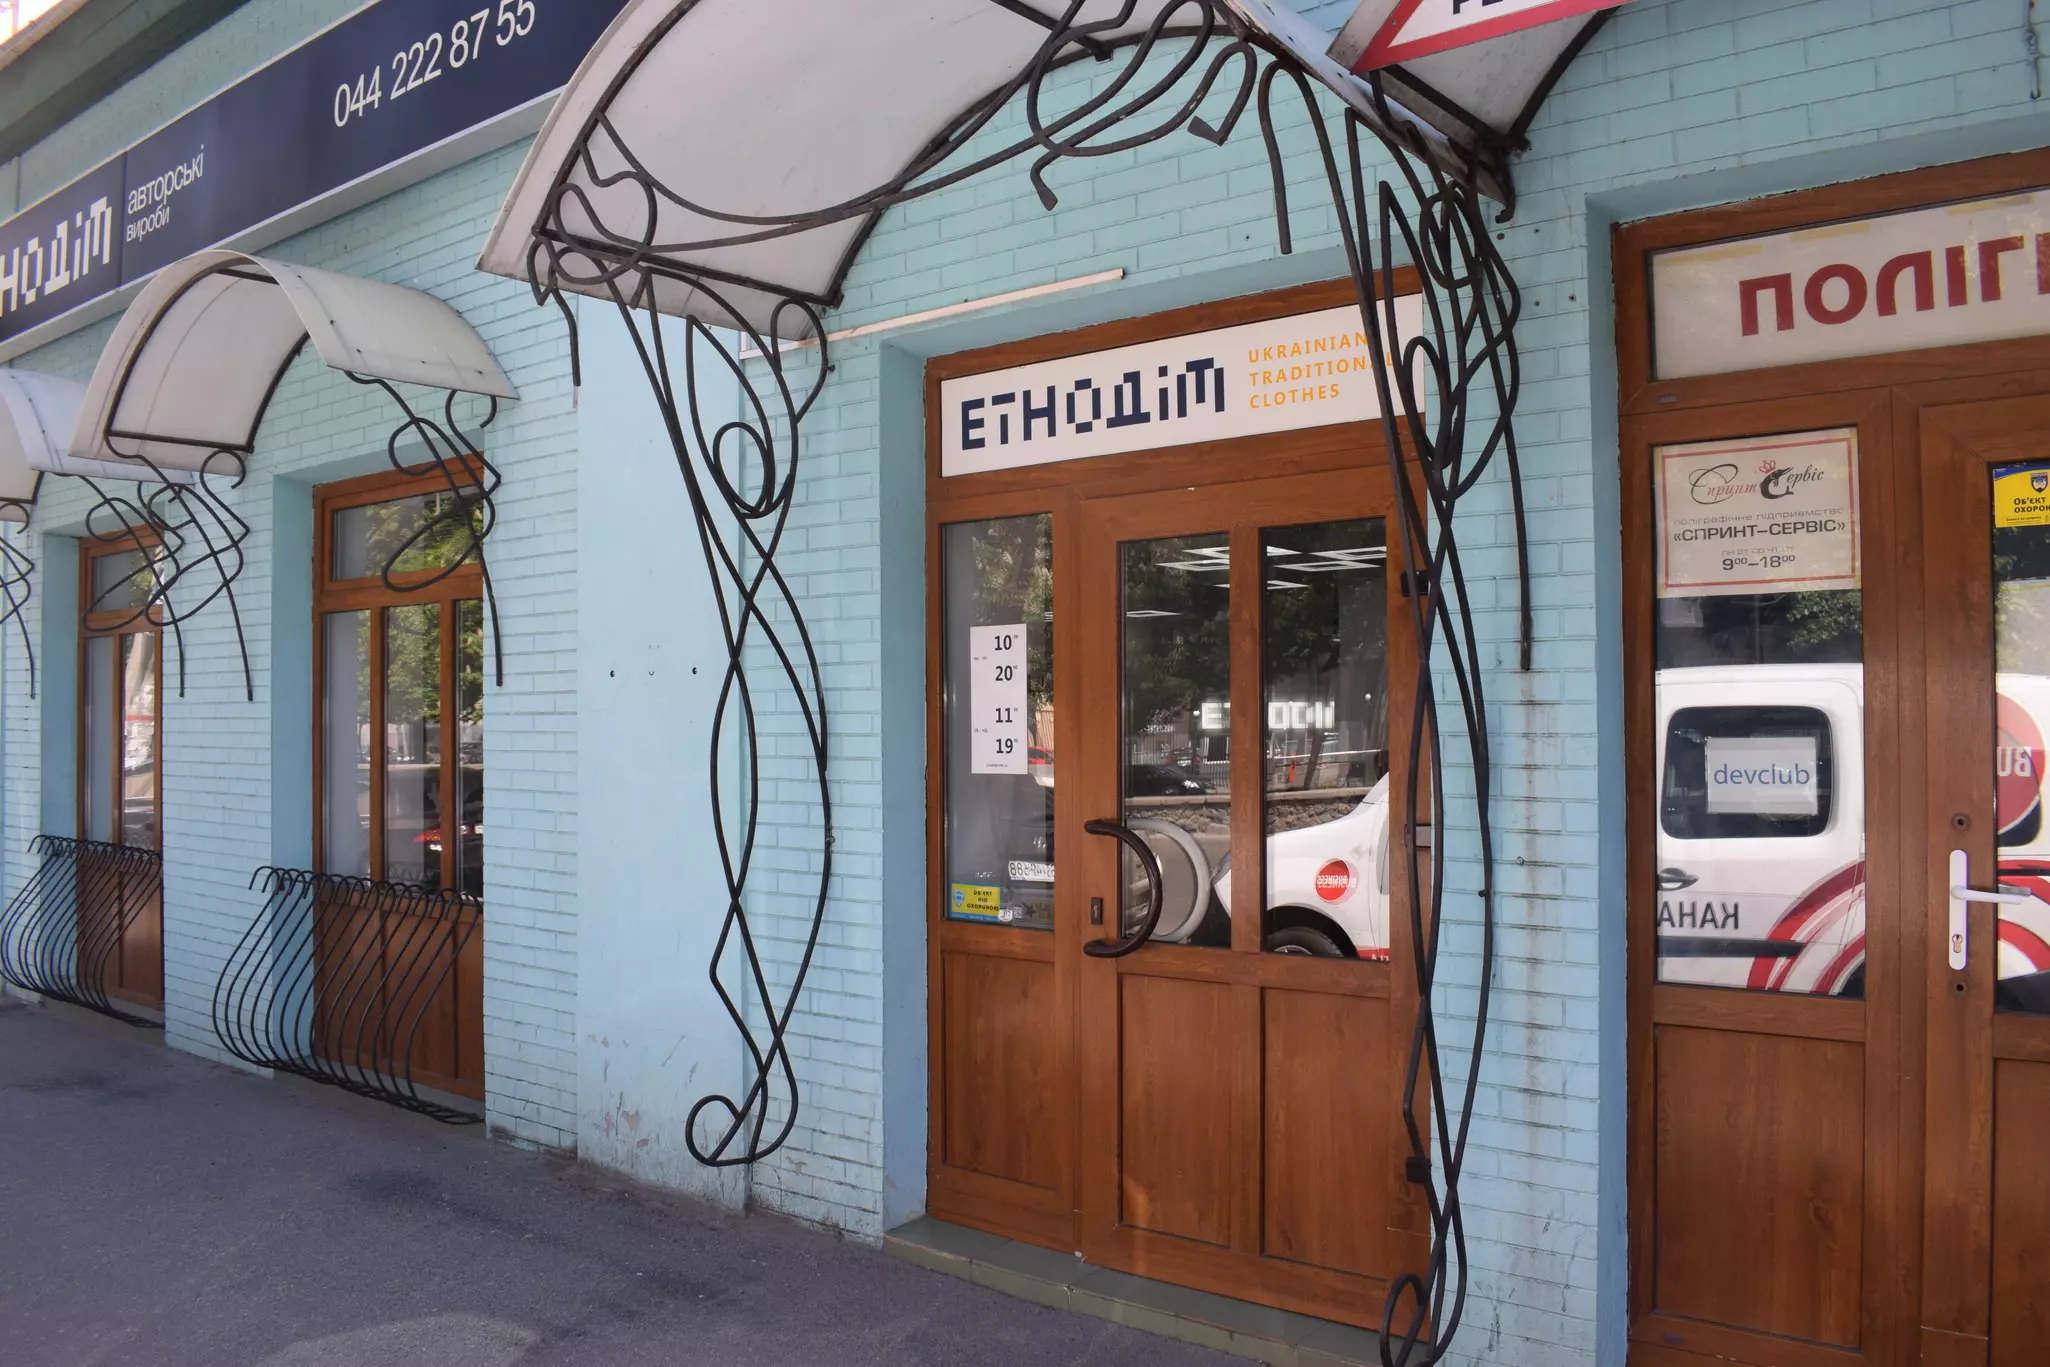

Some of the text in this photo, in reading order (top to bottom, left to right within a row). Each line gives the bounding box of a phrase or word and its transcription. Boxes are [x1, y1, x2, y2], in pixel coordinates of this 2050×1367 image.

[334, 0, 536, 127] 044 222 87 55
[127, 144, 204, 215] авторські
[126, 204, 170, 242] вироби
[1248, 332, 1369, 363] UKRAINIAN
[1249, 352, 1393, 386] TRADITIONL
[1249, 384, 1340, 409] CLOTHES
[1714, 763, 1810, 785] devclub
